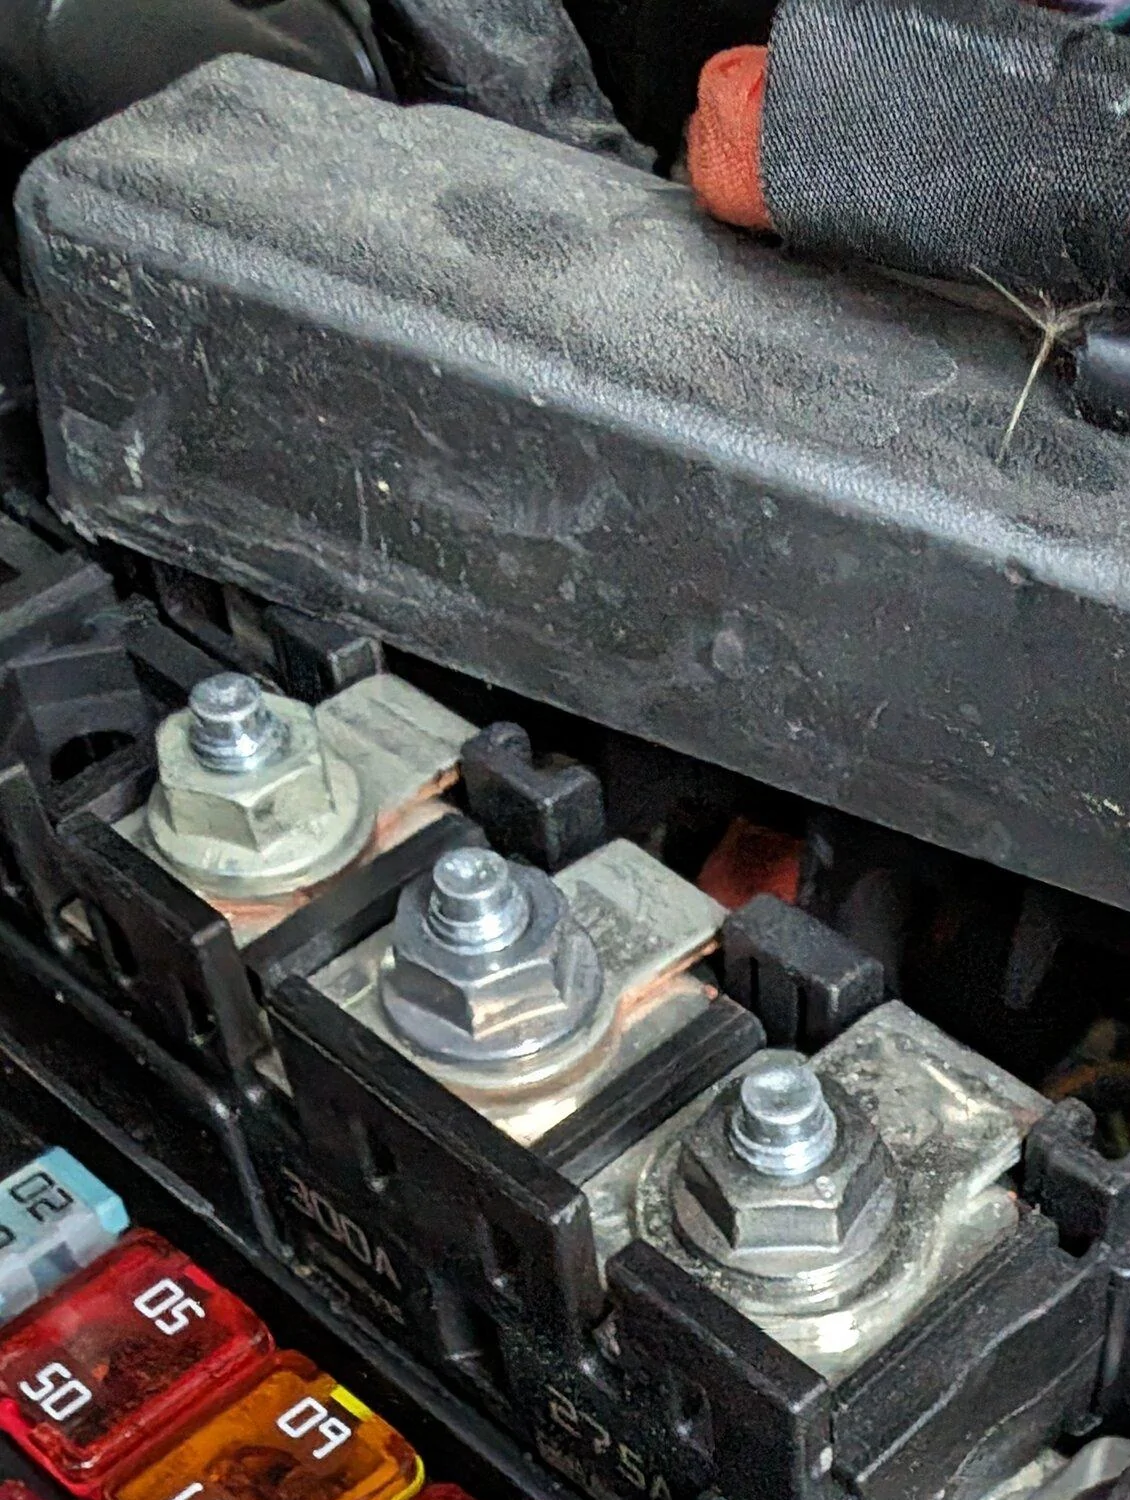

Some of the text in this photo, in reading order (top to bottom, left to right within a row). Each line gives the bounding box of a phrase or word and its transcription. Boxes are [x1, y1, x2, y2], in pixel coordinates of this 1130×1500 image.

[133, 1277, 206, 1336] 50
[19, 1361, 93, 1422] 50
[276, 1396, 352, 1460] 60
